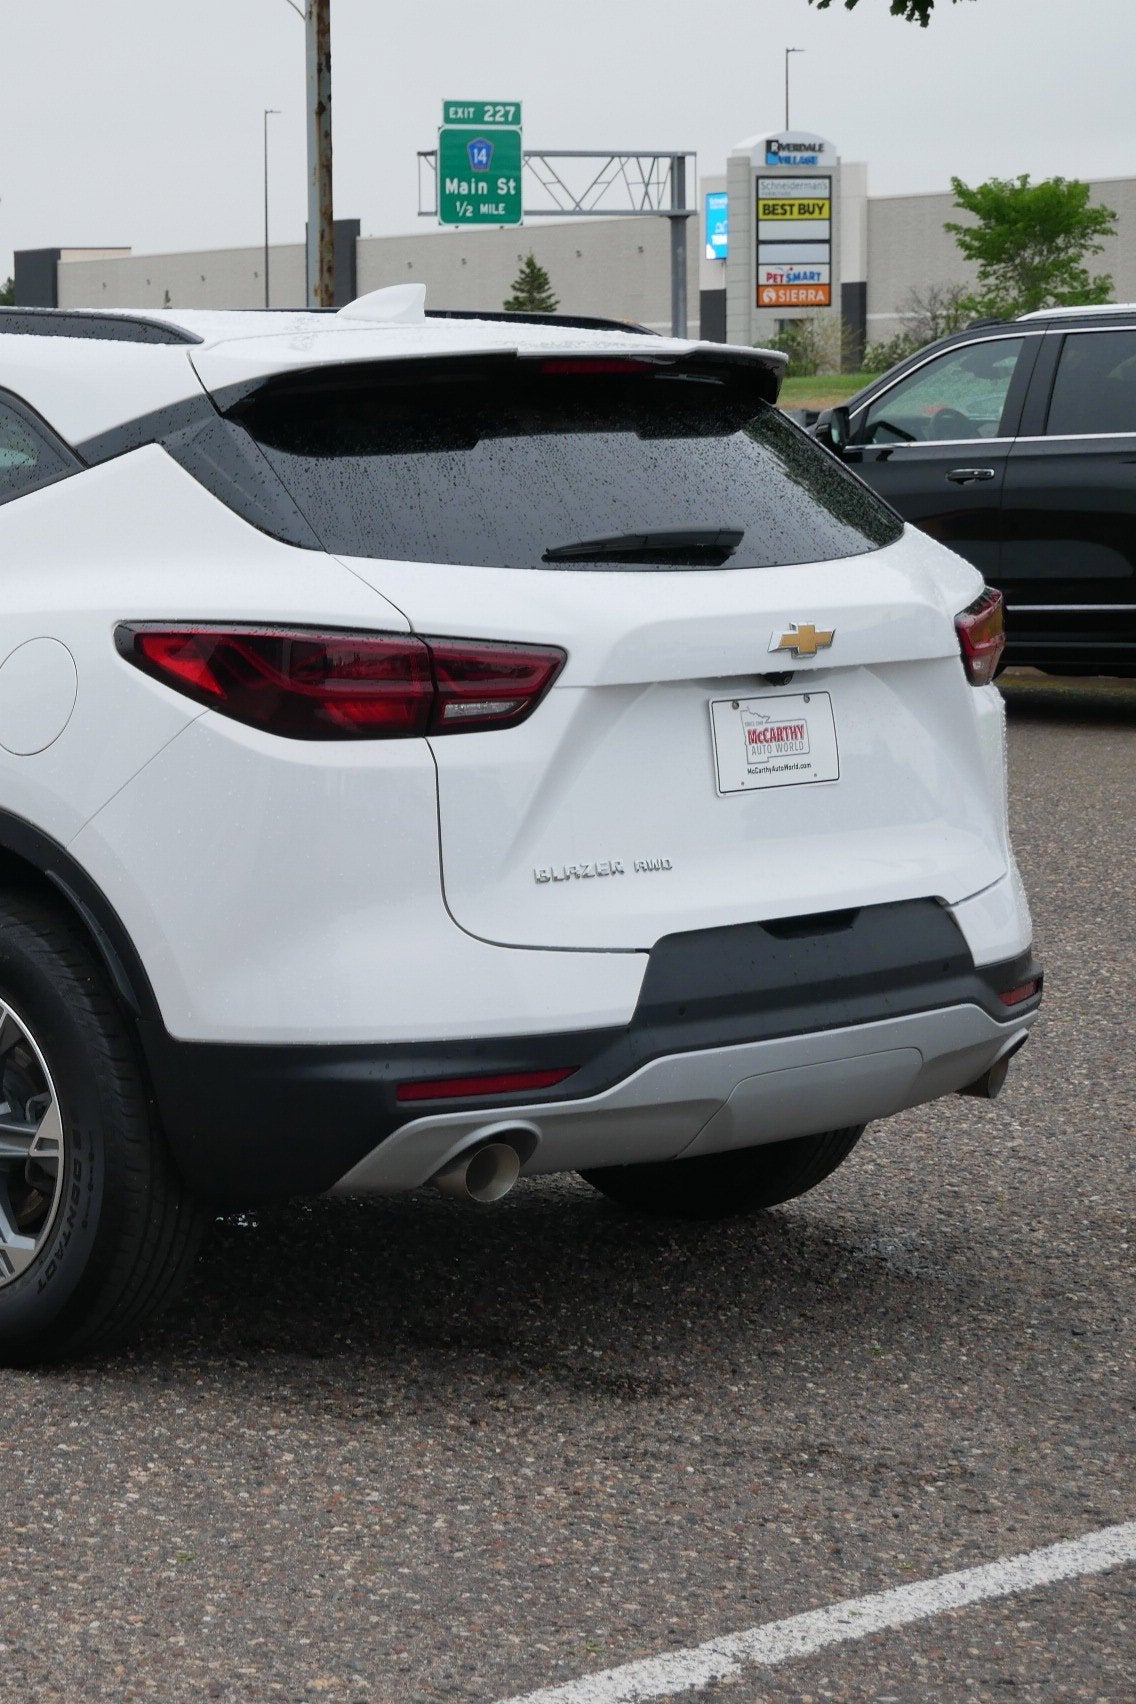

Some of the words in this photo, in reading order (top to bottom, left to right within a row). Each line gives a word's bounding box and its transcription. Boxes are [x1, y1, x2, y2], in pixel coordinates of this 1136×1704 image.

[449, 107, 475, 118] EXIT
[484, 105, 516, 121] 227
[766, 140, 824, 153] RIVERDALE
[473, 148, 487, 164] 14
[778, 155, 818, 166] VILLAGE
[445, 178, 488, 195] Main
[497, 178, 516, 195] St
[480, 204, 505, 215] MILE
[763, 204, 795, 216] BEST
[798, 203, 825, 215] BUY
[779, 289, 825, 302] SIERRA
[748, 724, 805, 745] McCARTHY
[752, 744, 772, 756] AUTO
[775, 741, 804, 753] WORLD
[747, 763, 811, 774] McCarthyAutoWorld.com
[534, 860, 624, 884] BLAZER
[633, 859, 672, 873] AWD
